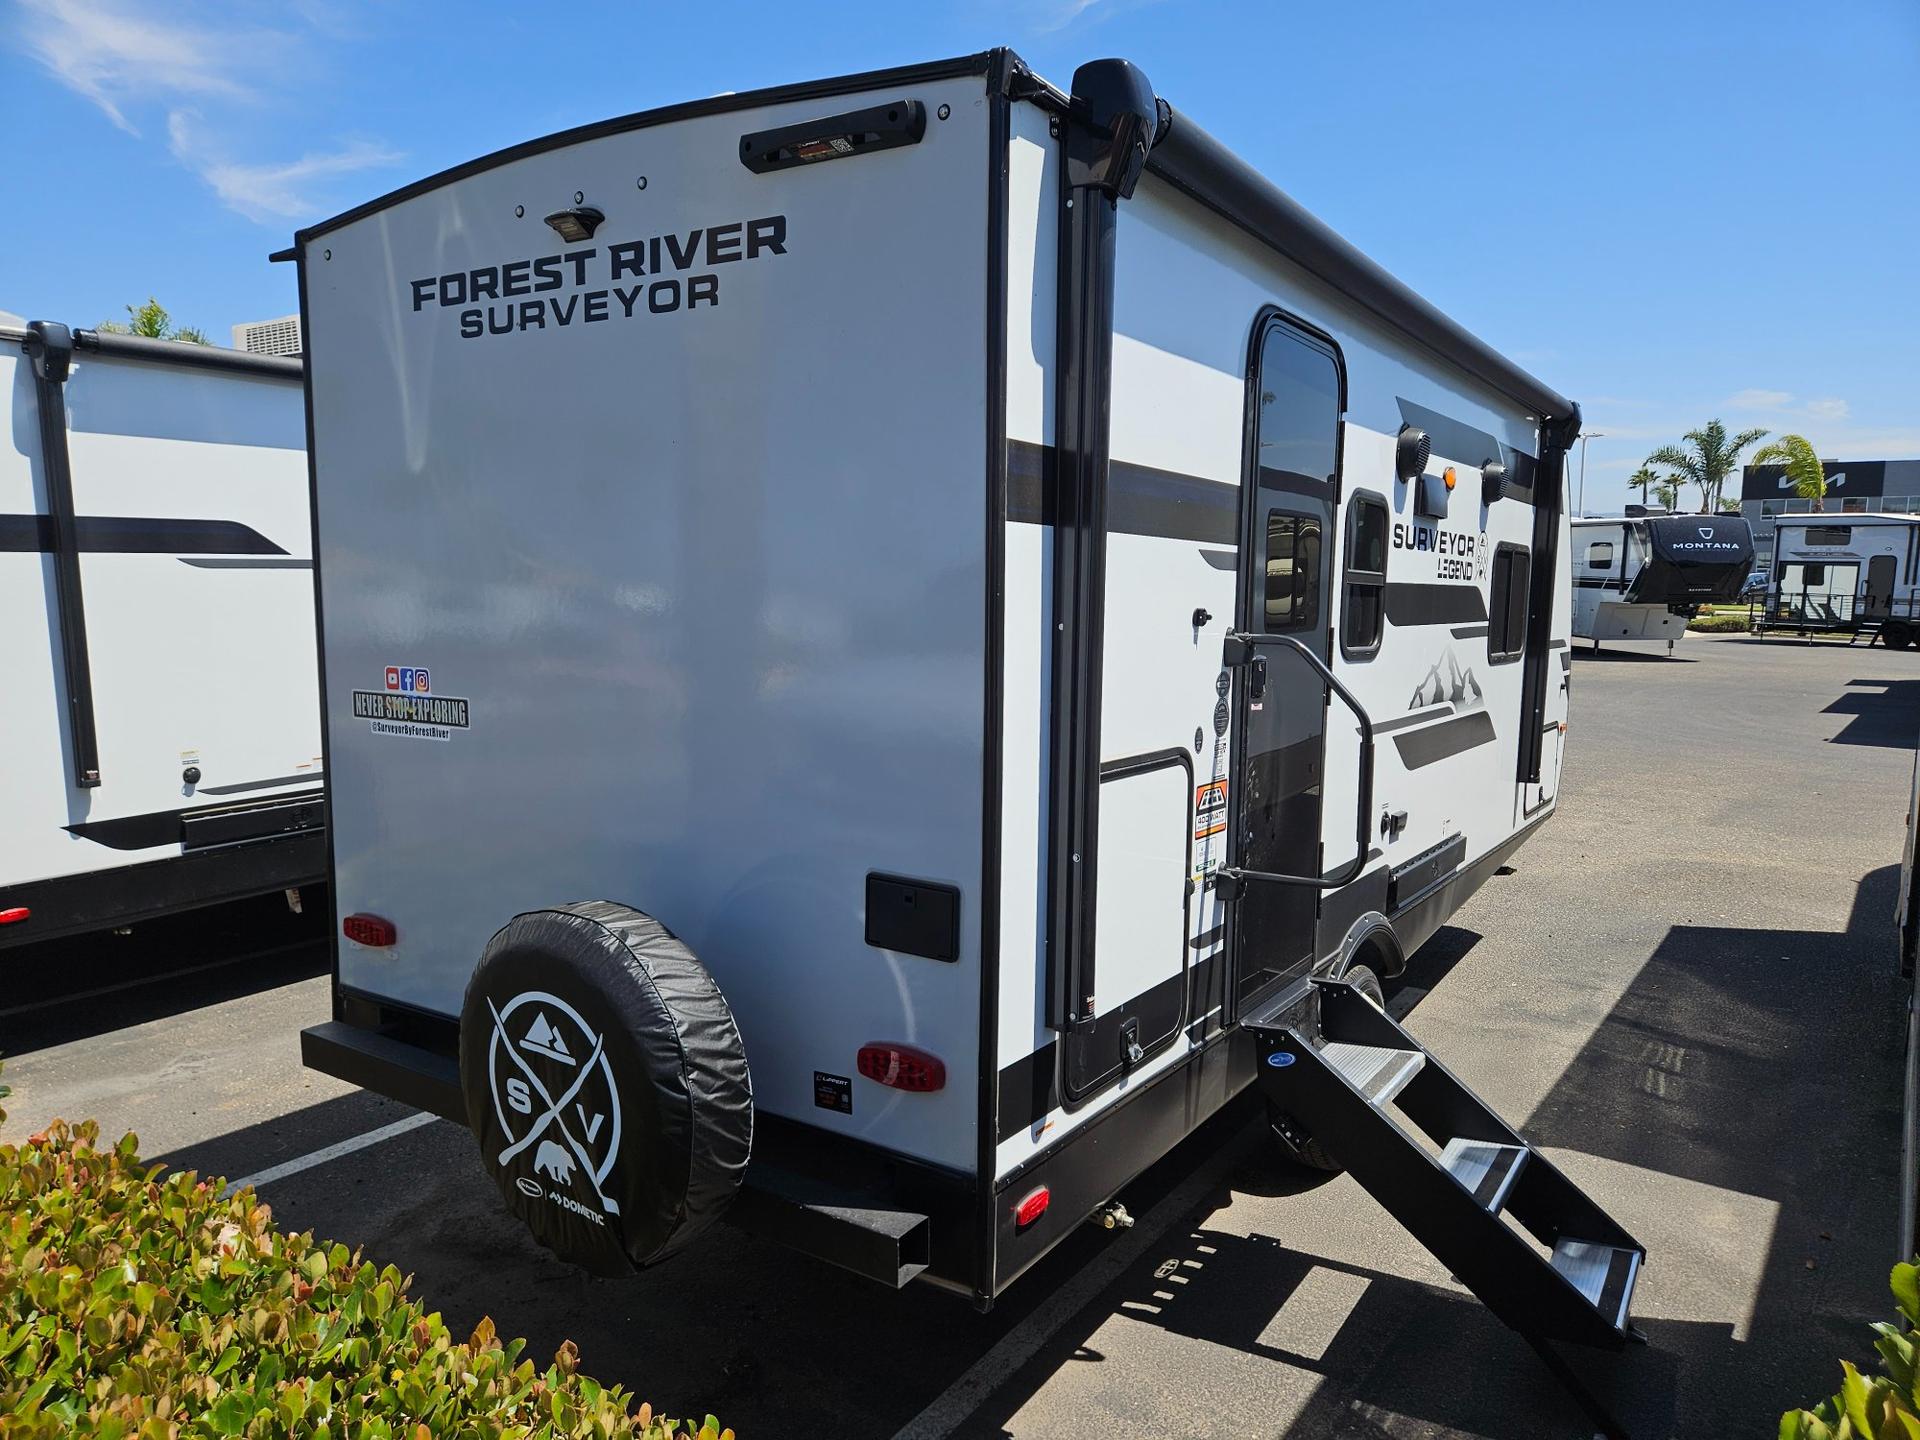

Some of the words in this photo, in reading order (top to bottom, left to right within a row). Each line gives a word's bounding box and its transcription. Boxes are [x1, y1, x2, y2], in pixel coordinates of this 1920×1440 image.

[410, 248, 597, 312] FOREST
[608, 214, 788, 281] RIVER
[460, 273, 719, 339] SURVEYOR
[1393, 523, 1475, 557] SURVEYOR
[1672, 542, 1740, 550] MONTANA
[1437, 557, 1473, 581] LEGEND
[355, 693, 384, 717] NEVER
[385, 695, 410, 720] STOP
[412, 697, 466, 725] EXPLORING
[372, 721, 449, 739] @SurveyorByForestRiver
[506, 1078, 532, 1114] S
[576, 1103, 605, 1144] V
[562, 1196, 605, 1226] DOMETIC
